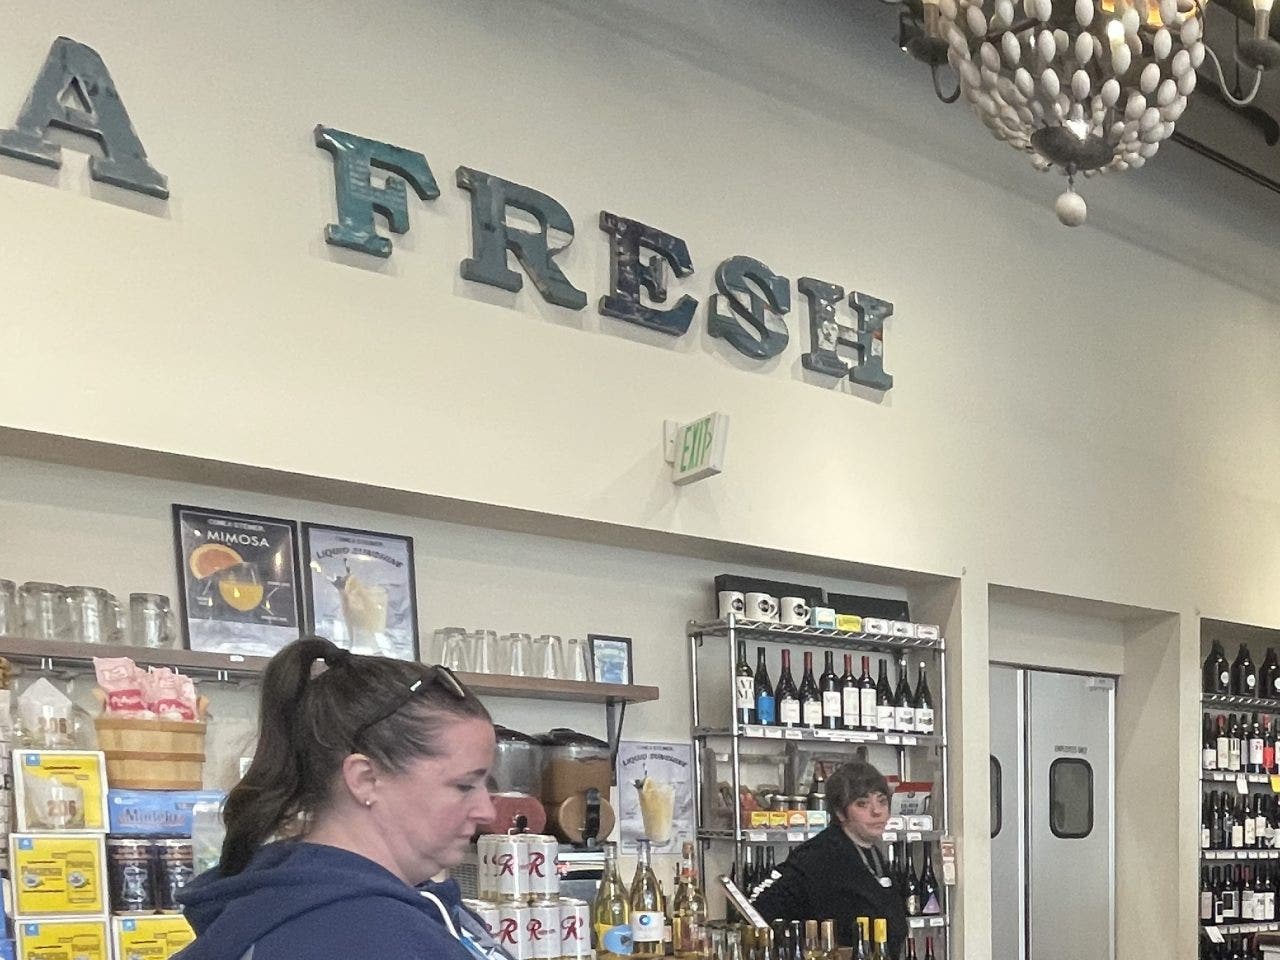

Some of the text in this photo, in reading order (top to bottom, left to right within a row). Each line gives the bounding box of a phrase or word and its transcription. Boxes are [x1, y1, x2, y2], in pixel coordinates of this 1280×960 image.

[0, 36, 895, 391] A FRESH
[680, 417, 711, 472] EXIT
[207, 530, 270, 547] MIMOSA
[316, 547, 349, 559] LIQUID
